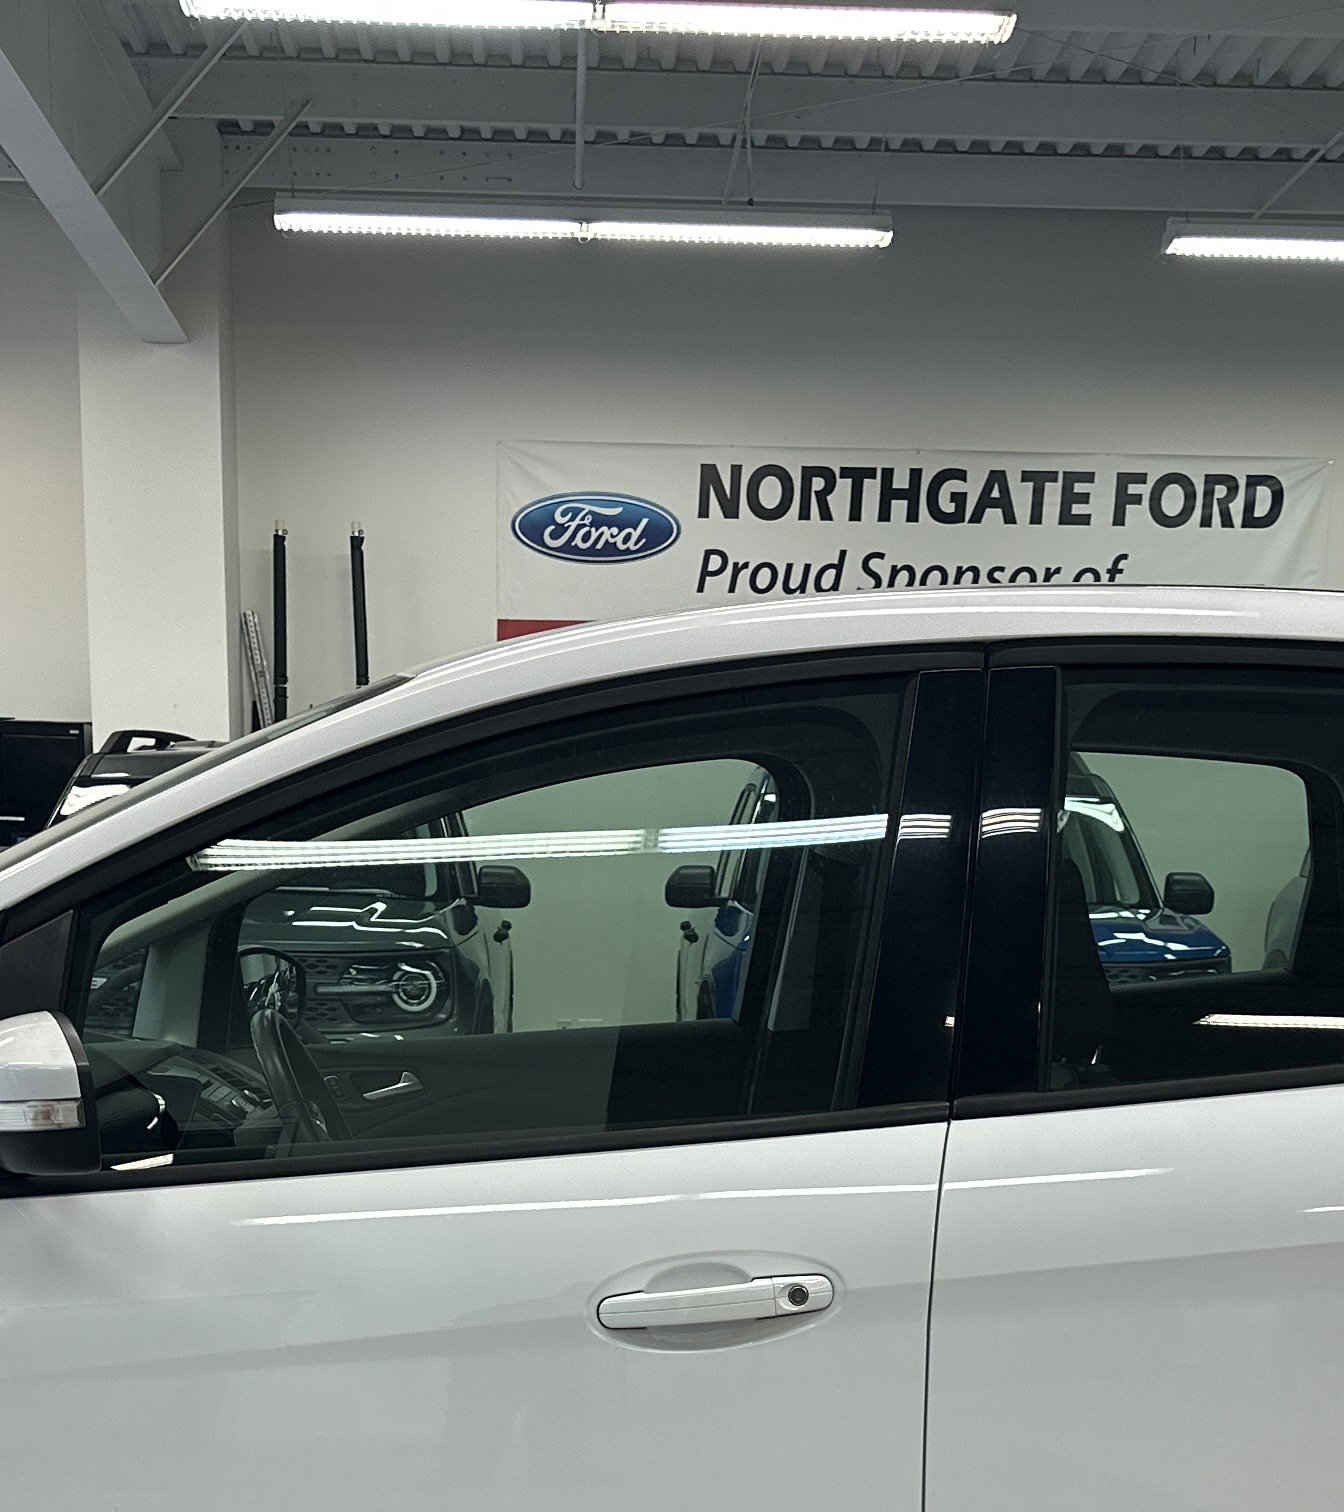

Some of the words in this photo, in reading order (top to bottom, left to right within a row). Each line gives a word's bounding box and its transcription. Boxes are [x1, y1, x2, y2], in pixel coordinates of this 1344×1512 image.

[697, 463, 1096, 526] NORTHGATE
[1111, 471, 1286, 530] FORD
[542, 502, 648, 551] Ford
[696, 548, 848, 595] Proud
